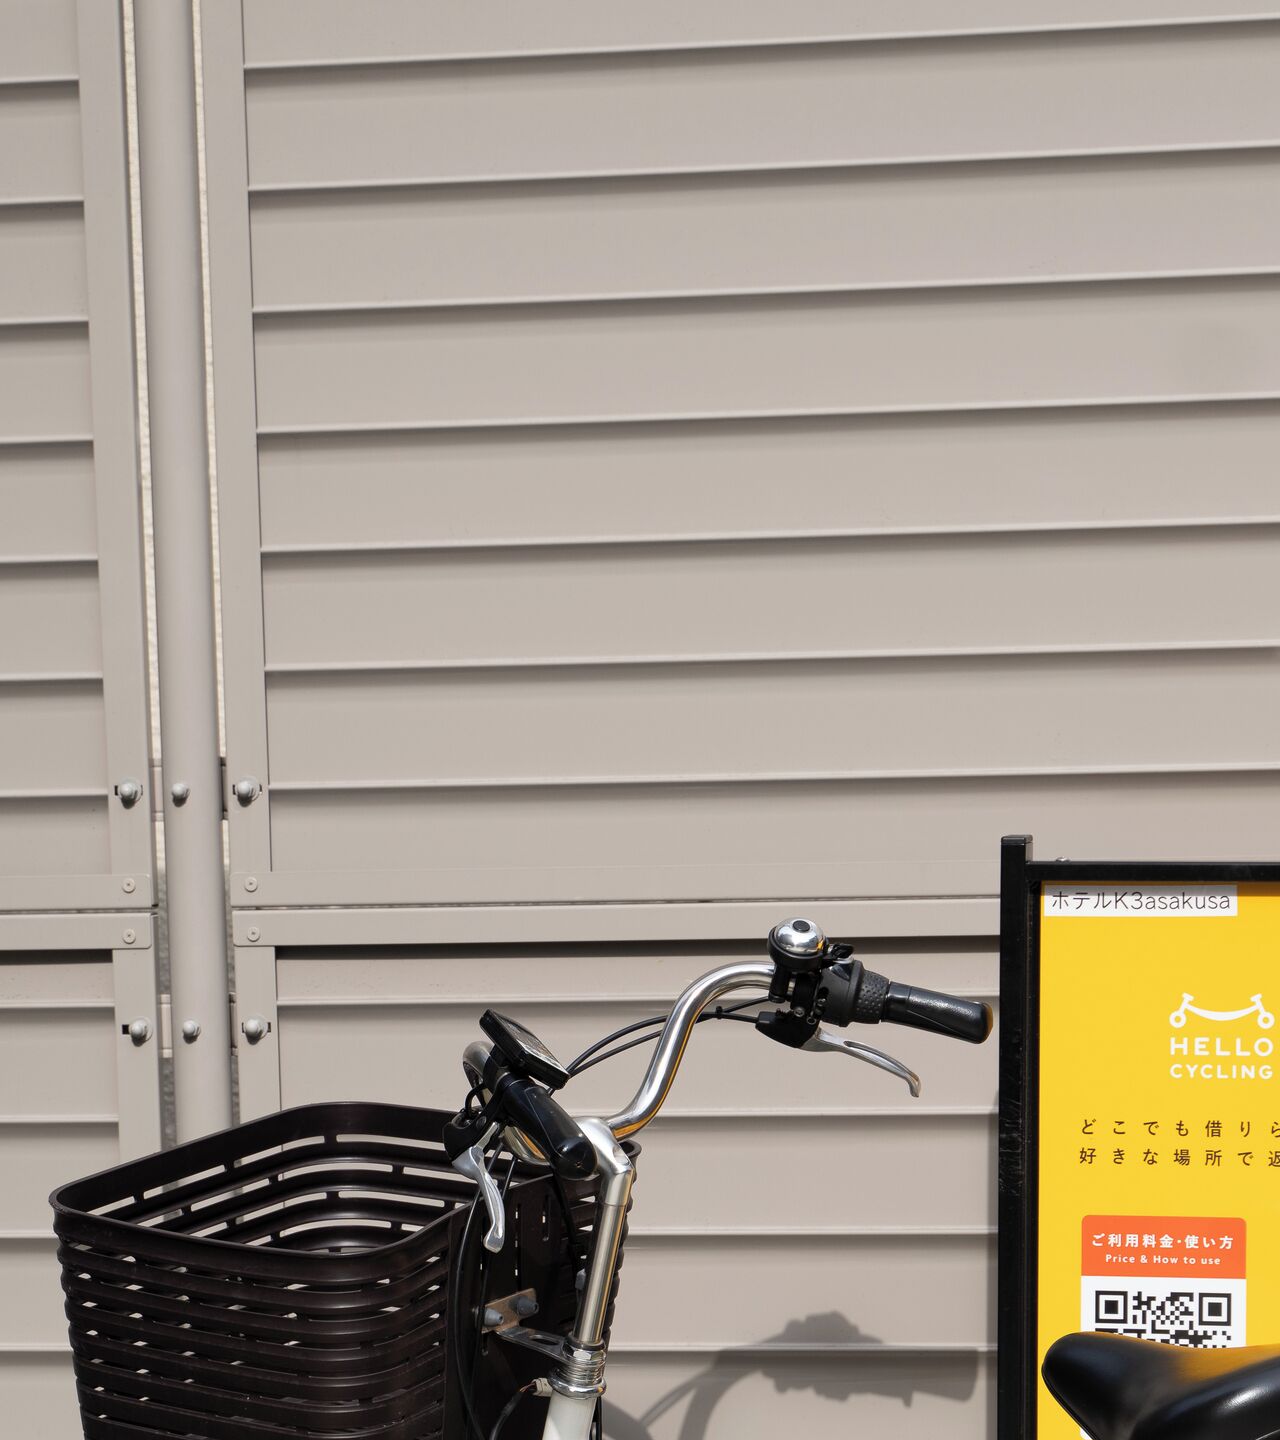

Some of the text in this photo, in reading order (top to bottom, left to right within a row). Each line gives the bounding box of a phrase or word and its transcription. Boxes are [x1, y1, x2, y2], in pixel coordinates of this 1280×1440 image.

[1052, 890, 1231, 910] ホテルK3asakusa
[1169, 1036, 1274, 1057] HELLO
[1169, 1063, 1274, 1080] CYCLING
[1091, 1233, 1234, 1250] ご利用料金・使い方
[1105, 1254, 1221, 1265] Price & How to use
